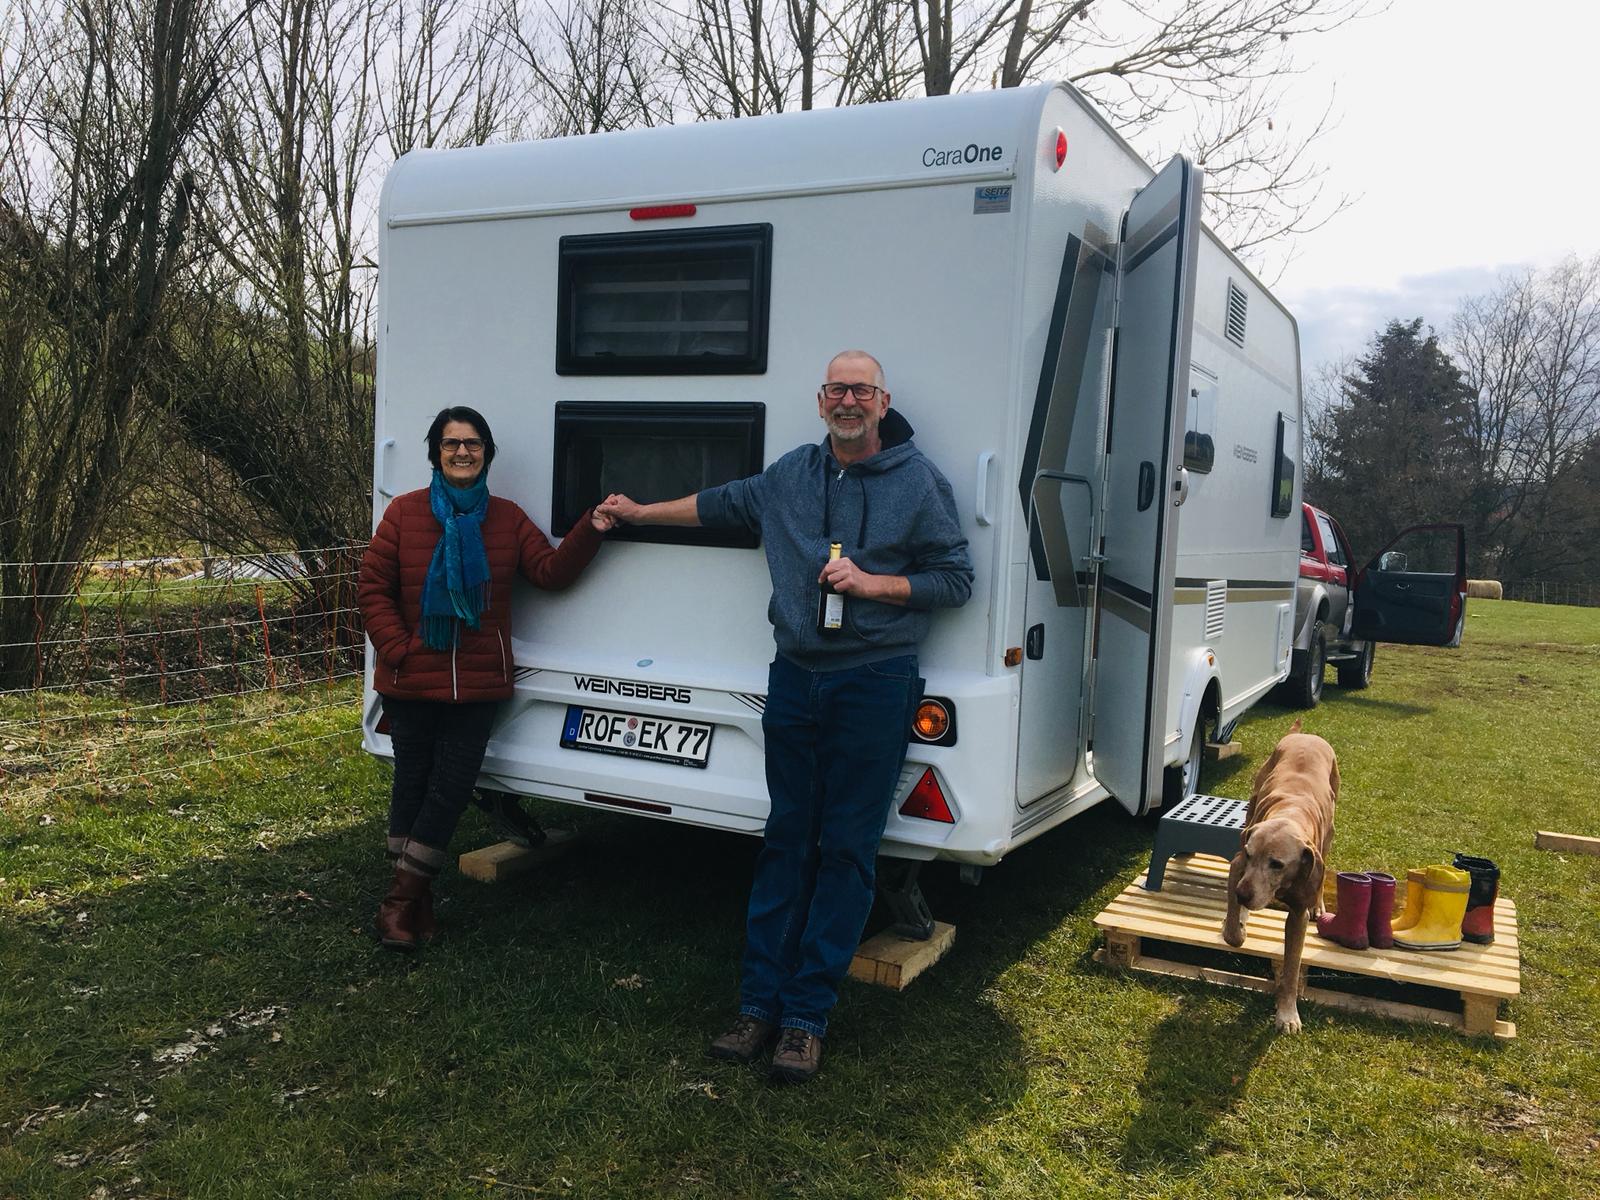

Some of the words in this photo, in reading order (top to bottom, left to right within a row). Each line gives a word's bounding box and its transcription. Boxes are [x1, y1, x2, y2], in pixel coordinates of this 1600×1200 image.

[922, 143, 1003, 167] CaraOne
[984, 187, 1010, 196] SEITZ
[574, 675, 691, 704] WEINSBERG
[569, 727, 575, 736] D
[578, 712, 626, 743] ROF
[638, 720, 673, 751] EK
[677, 726, 709, 756] 77
